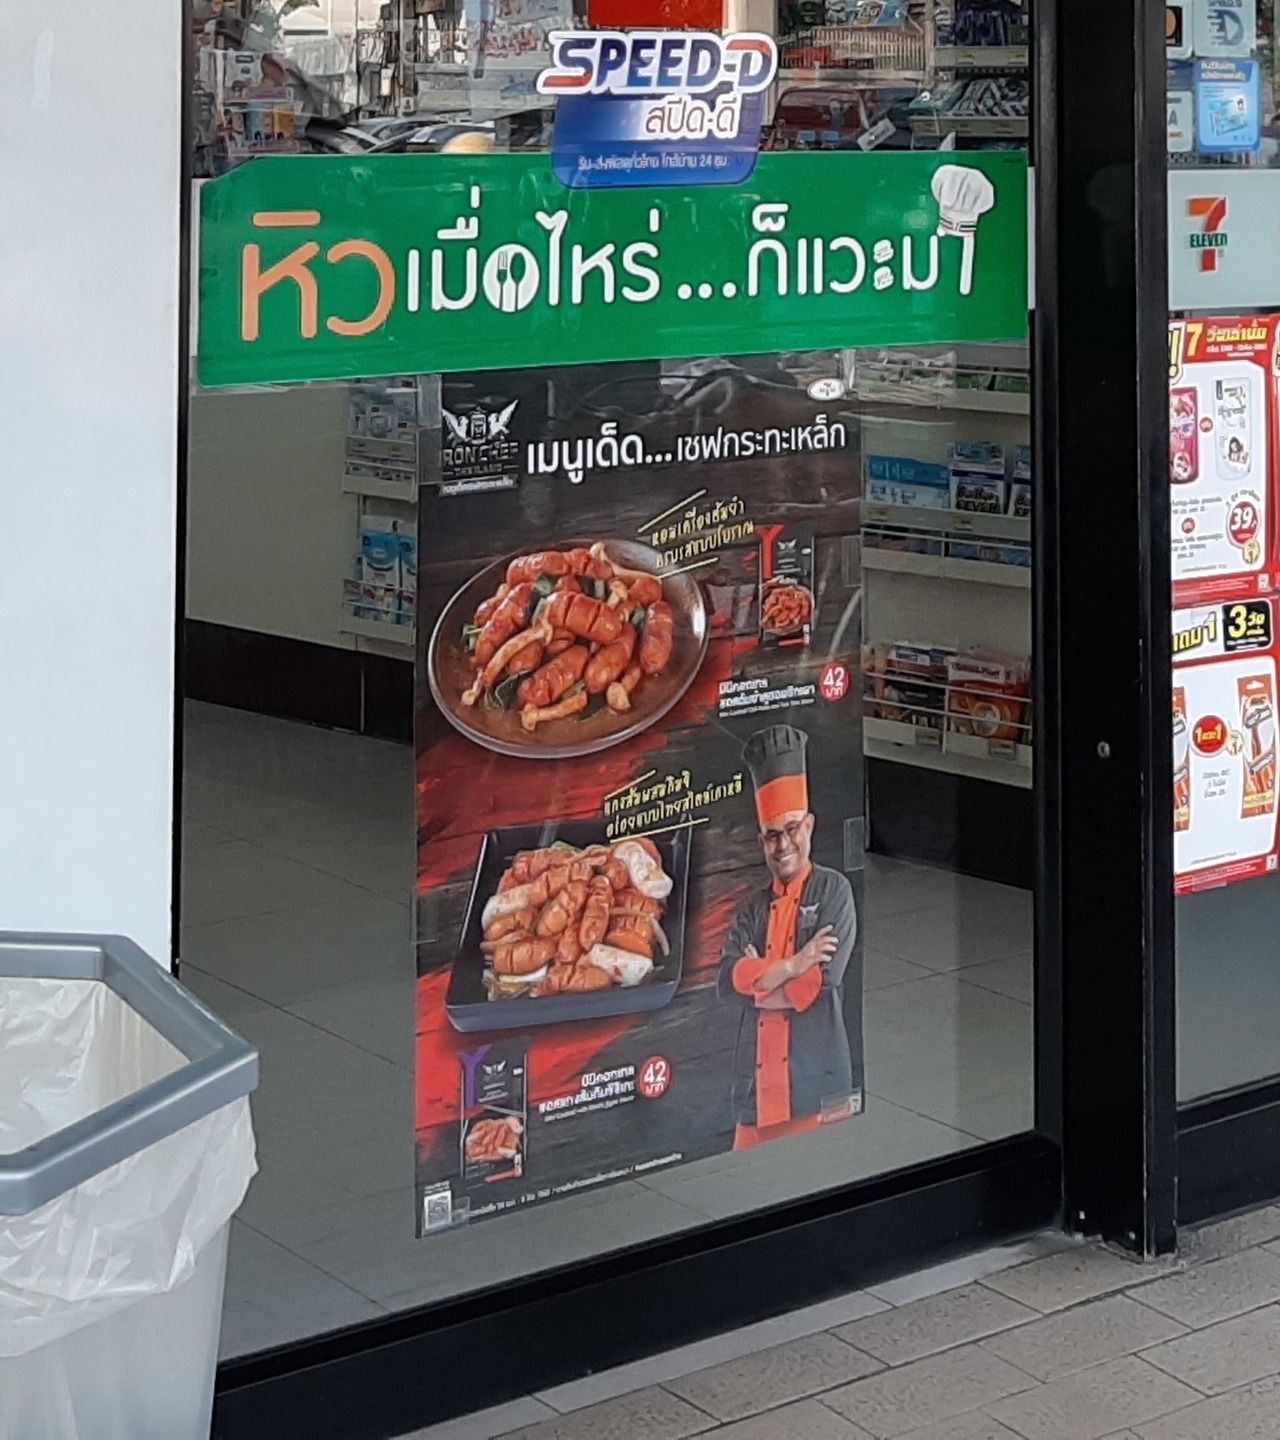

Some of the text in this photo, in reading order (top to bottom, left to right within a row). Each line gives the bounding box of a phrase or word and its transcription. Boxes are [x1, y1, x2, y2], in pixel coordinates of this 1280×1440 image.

[543, 38, 772, 88] SPEED-D
[645, 97, 737, 134] สปีด-ดี
[699, 155, 712, 167] 24
[1188, 196, 1227, 272] 7
[1187, 323, 1204, 356] 7
[1229, 605, 1247, 636] 3
[823, 667, 845, 686] 42
[644, 1061, 666, 1083] 42
